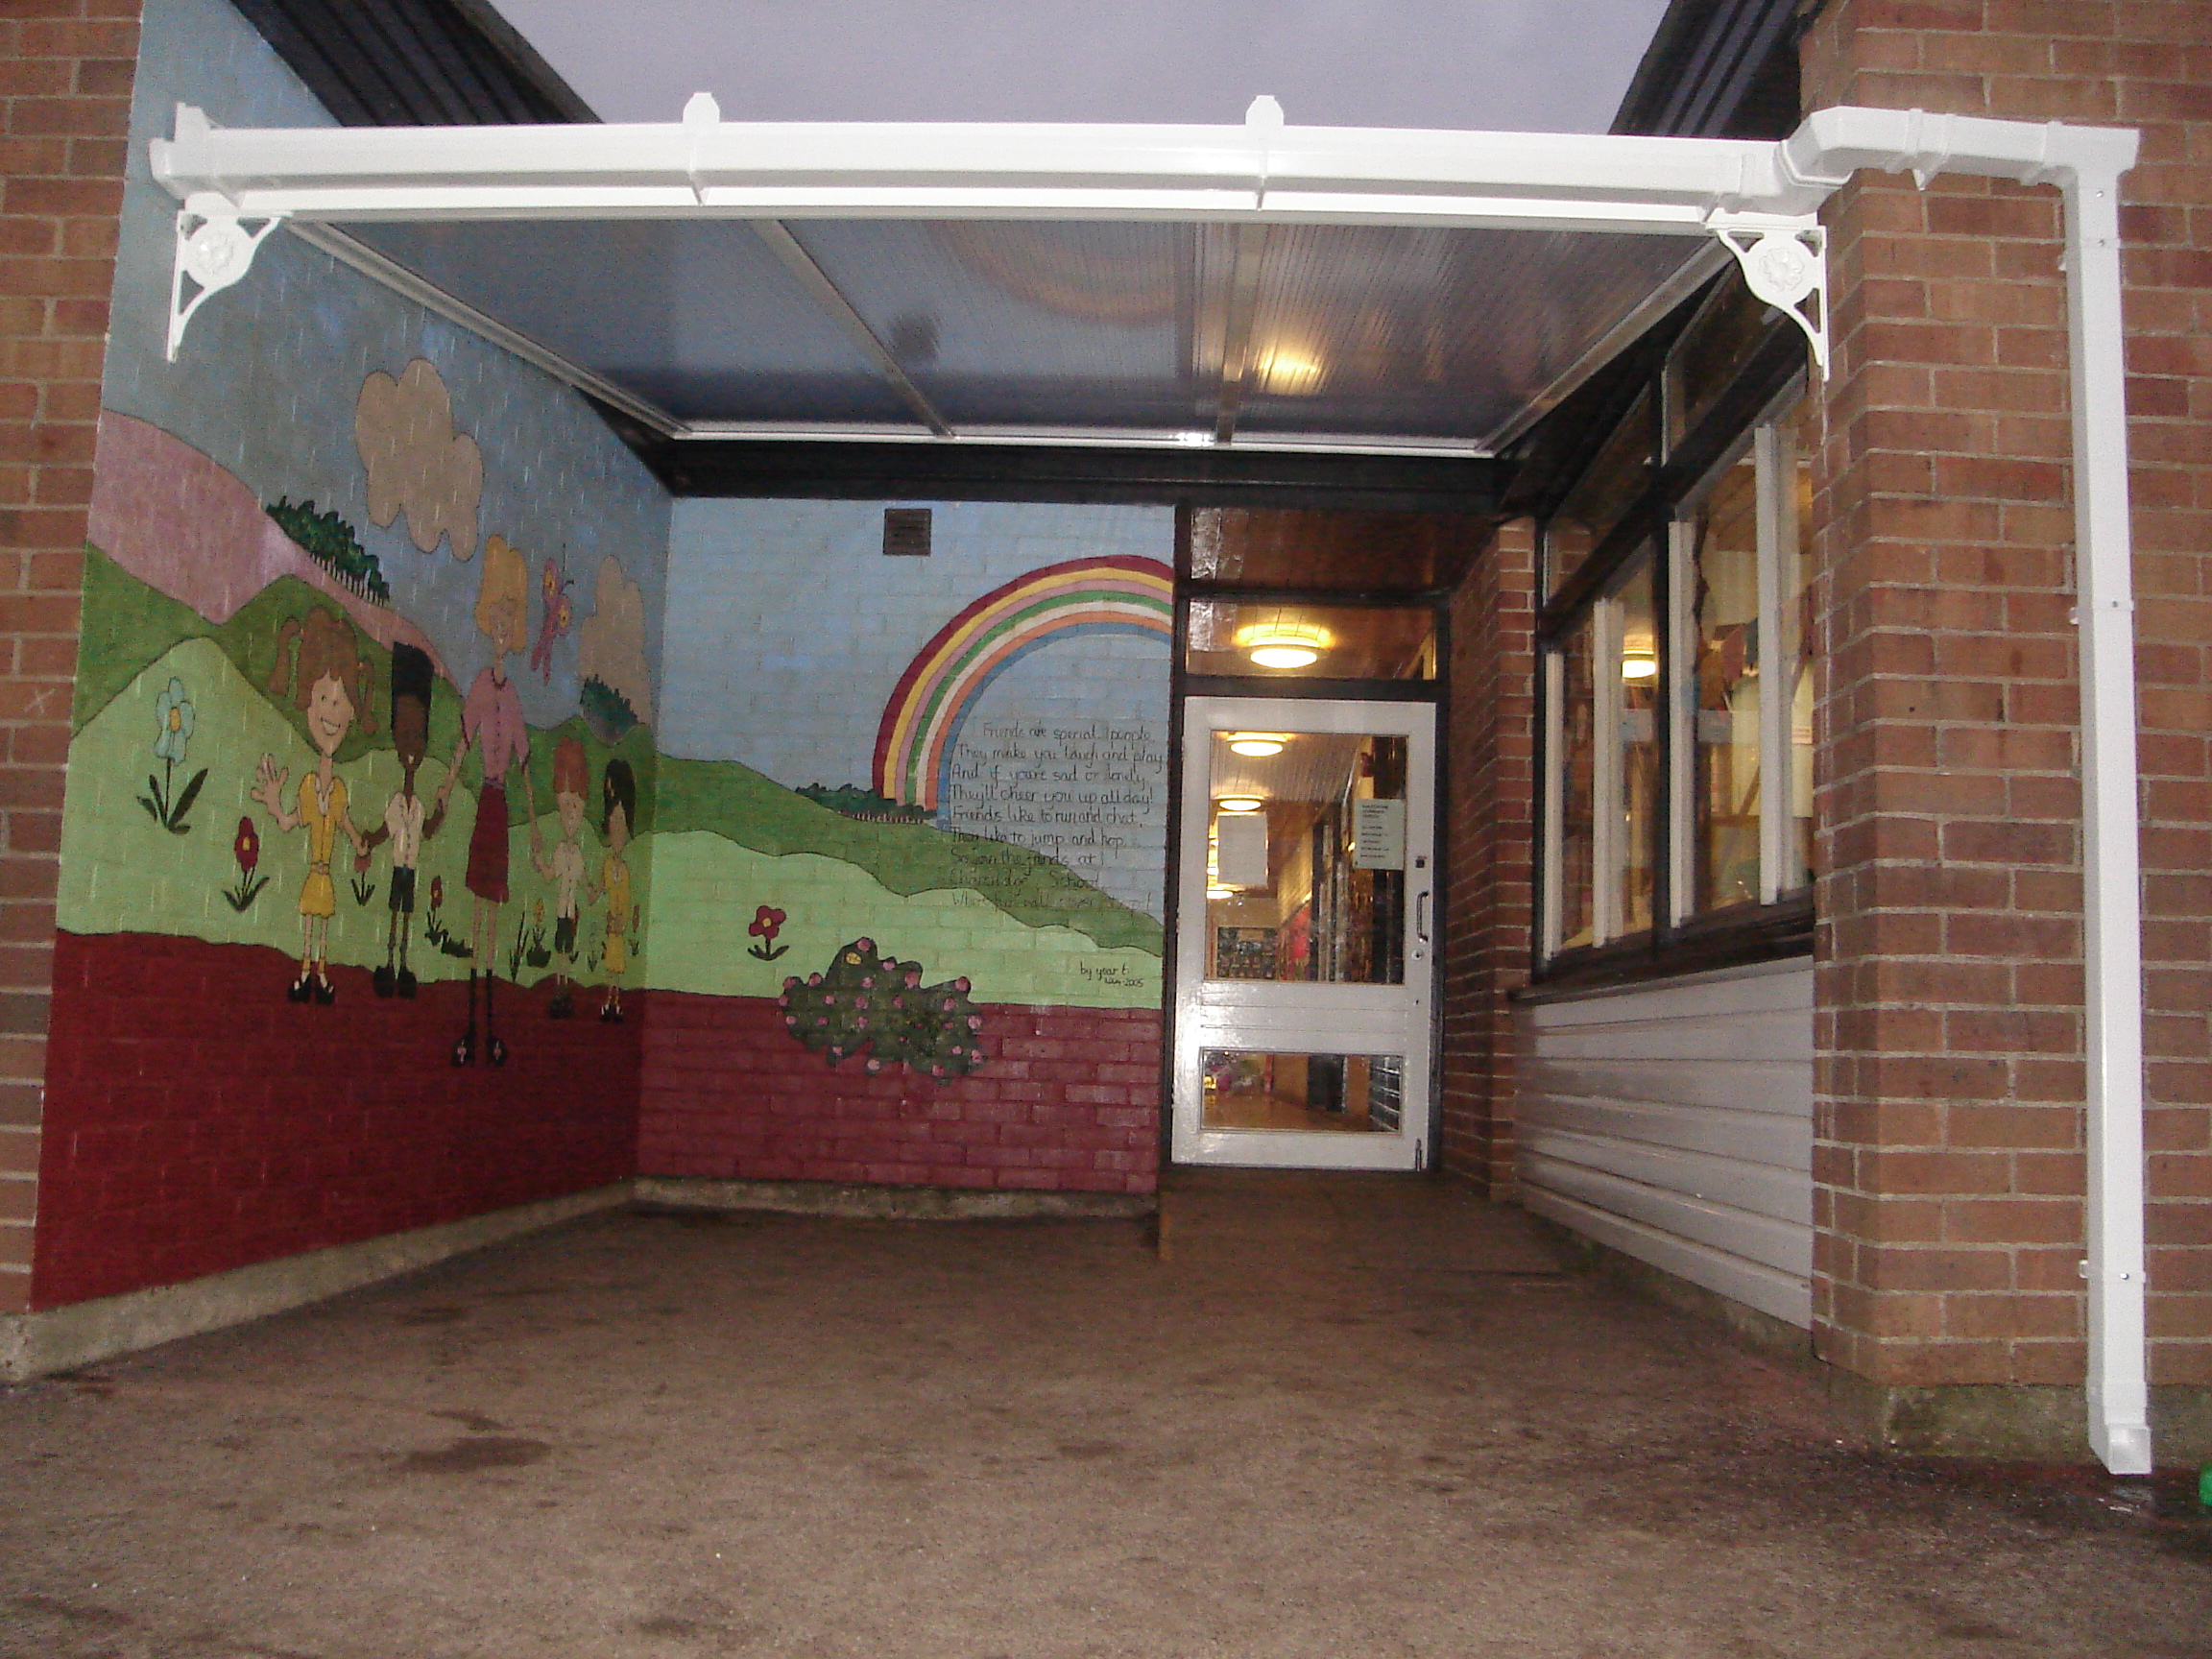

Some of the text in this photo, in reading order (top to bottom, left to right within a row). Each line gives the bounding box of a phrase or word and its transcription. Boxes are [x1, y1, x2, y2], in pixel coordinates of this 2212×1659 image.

[984, 720, 1024, 738] Friends
[1029, 727, 1046, 738] are
[1053, 724, 1096, 747] special
[956, 743, 987, 766] They
[993, 742, 1026, 759] make
[1033, 749, 1057, 768] you
[1065, 742, 1099, 769] laugh
[1101, 745, 1127, 760] and
[951, 762, 978, 780] And
[989, 764, 999, 789] if
[1052, 764, 1077, 781] sad
[1084, 771, 1099, 781] or
[999, 785, 1038, 802] cheer
[1044, 791, 1071, 810] you
[1078, 792, 1097, 810] up
[1100, 788, 1120, 805] all
[1122, 786, 1152, 815] day!
[952, 805, 1002, 823] Friends
[1007, 805, 1035, 823] like
[1040, 808, 1053, 824] to
[1055, 812, 1076, 824] run
[1078, 806, 1101, 825] and
[985, 826, 1007, 843] like
[1010, 830, 1025, 844] to
[1030, 829, 1064, 858] jump
[1071, 827, 1095, 847] and
[1001, 847, 1022, 866] the
[1077, 853, 1097, 866] at
[1080, 961, 1093, 981] by
[1096, 968, 1118, 981] year
